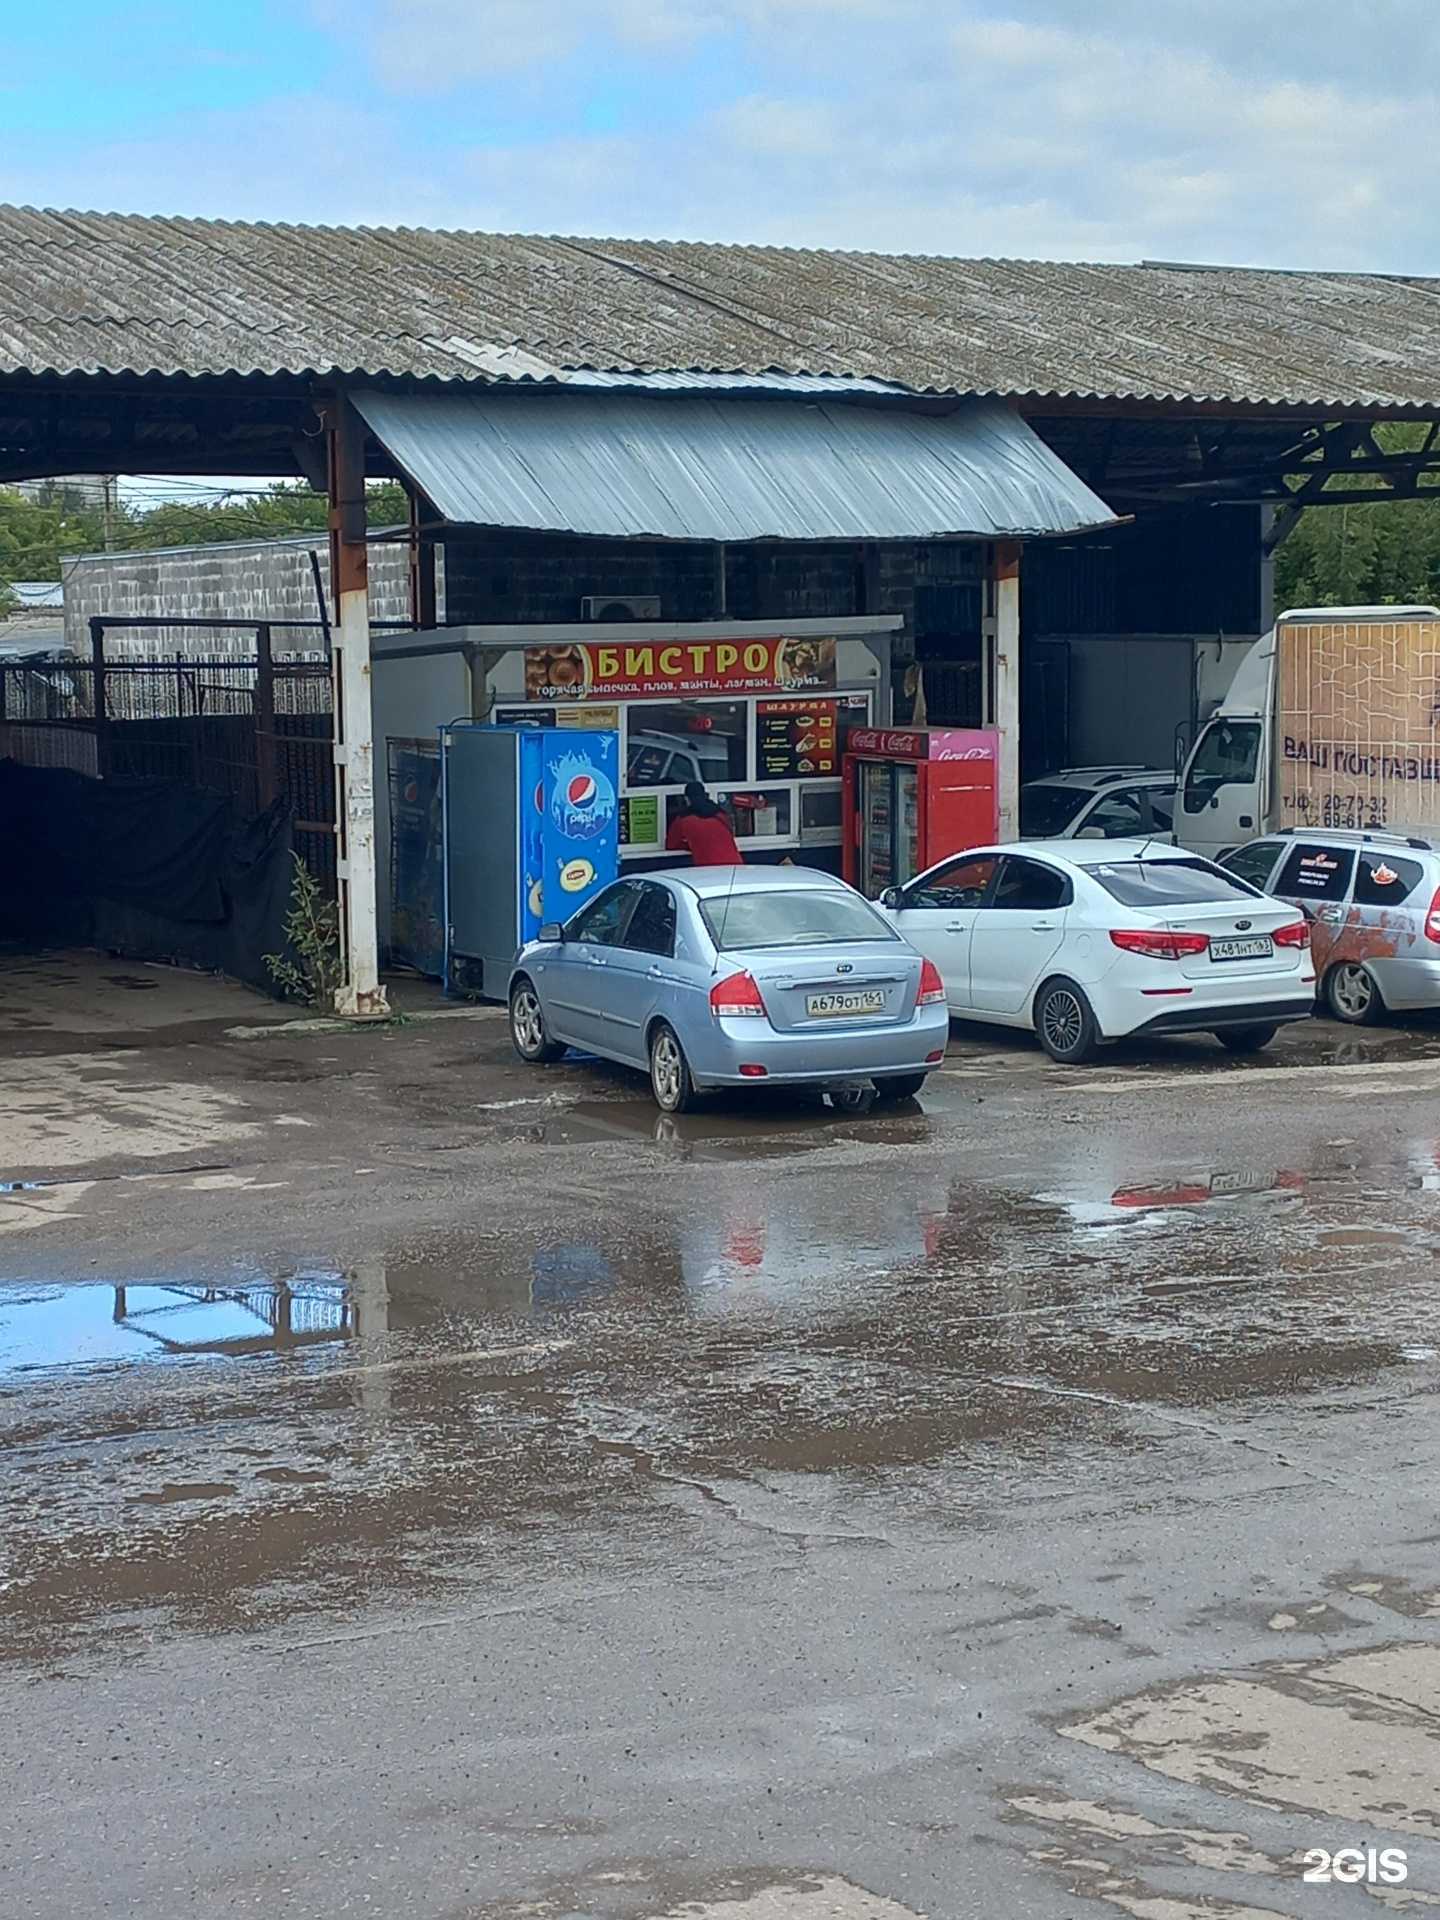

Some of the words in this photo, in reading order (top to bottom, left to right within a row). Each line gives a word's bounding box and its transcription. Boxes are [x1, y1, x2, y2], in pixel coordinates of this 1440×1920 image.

[598, 643, 769, 677] БИСТРО
[536, 683, 584, 697] горячая
[1284, 736, 1328, 769] ВАШ
